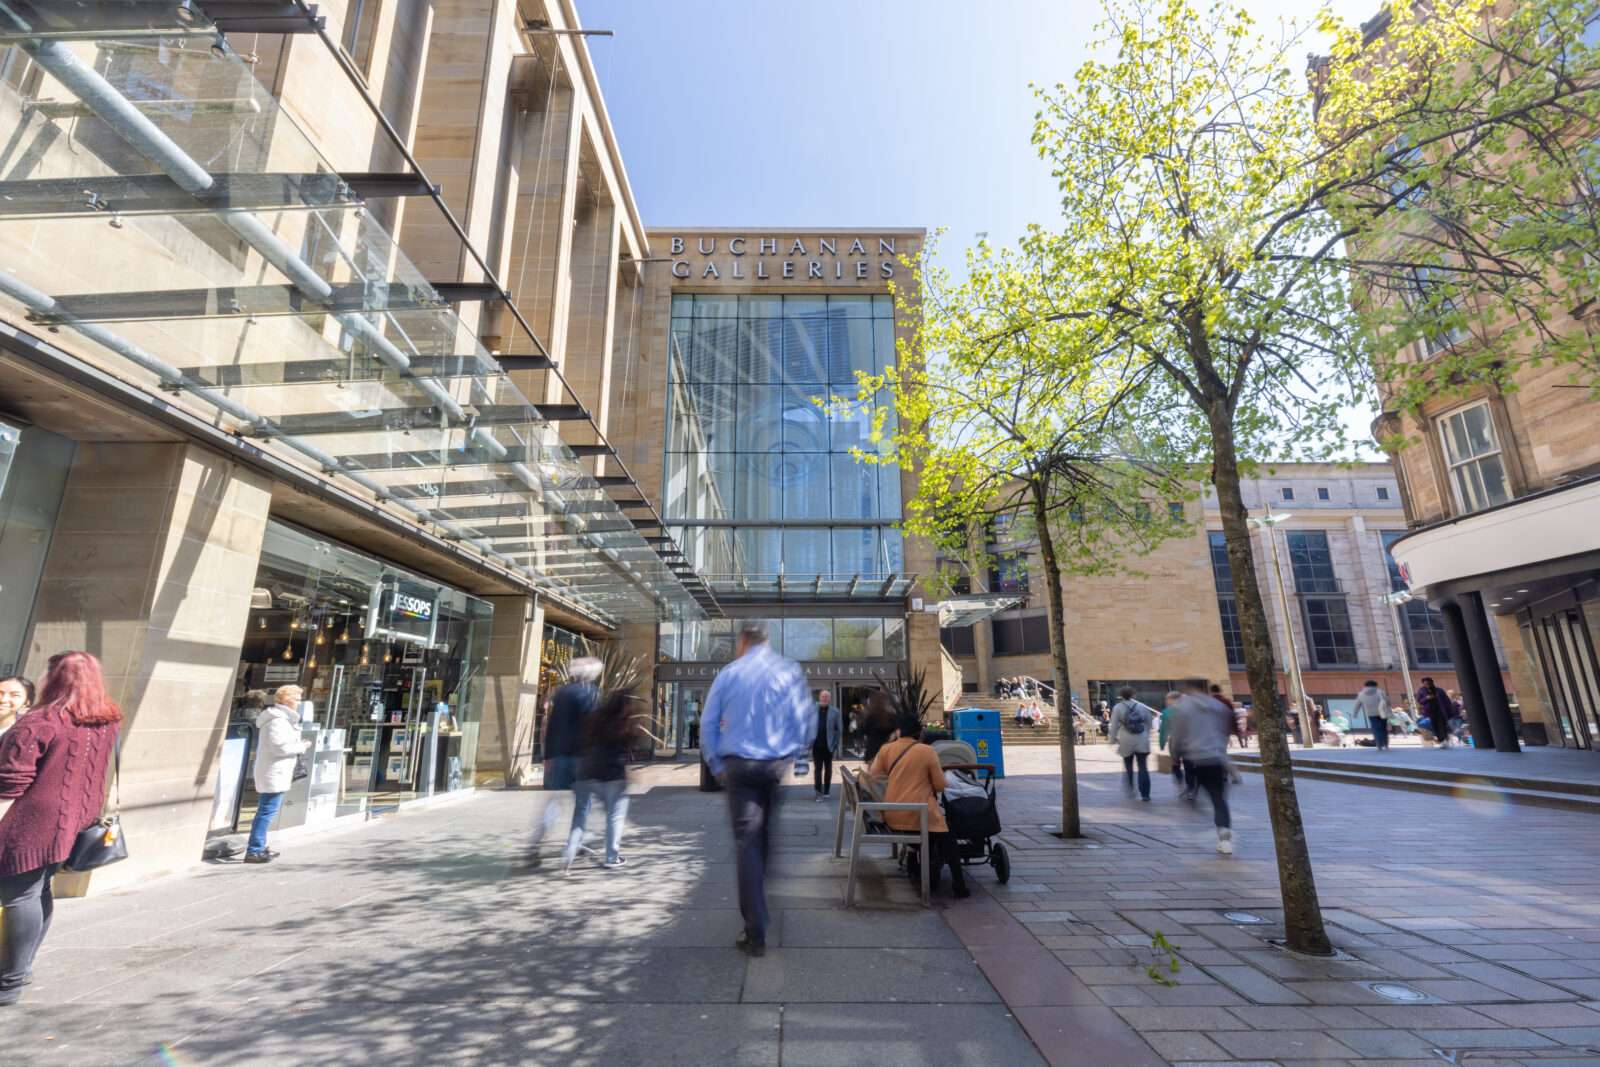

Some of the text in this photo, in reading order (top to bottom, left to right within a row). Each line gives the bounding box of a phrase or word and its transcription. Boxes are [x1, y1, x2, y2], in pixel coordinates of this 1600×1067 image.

[671, 237, 896, 255] BUCHANAN
[672, 260, 894, 279] GALLERIES
[390, 592, 432, 616] JESSOPS
[675, 667, 720, 676] BUCH
